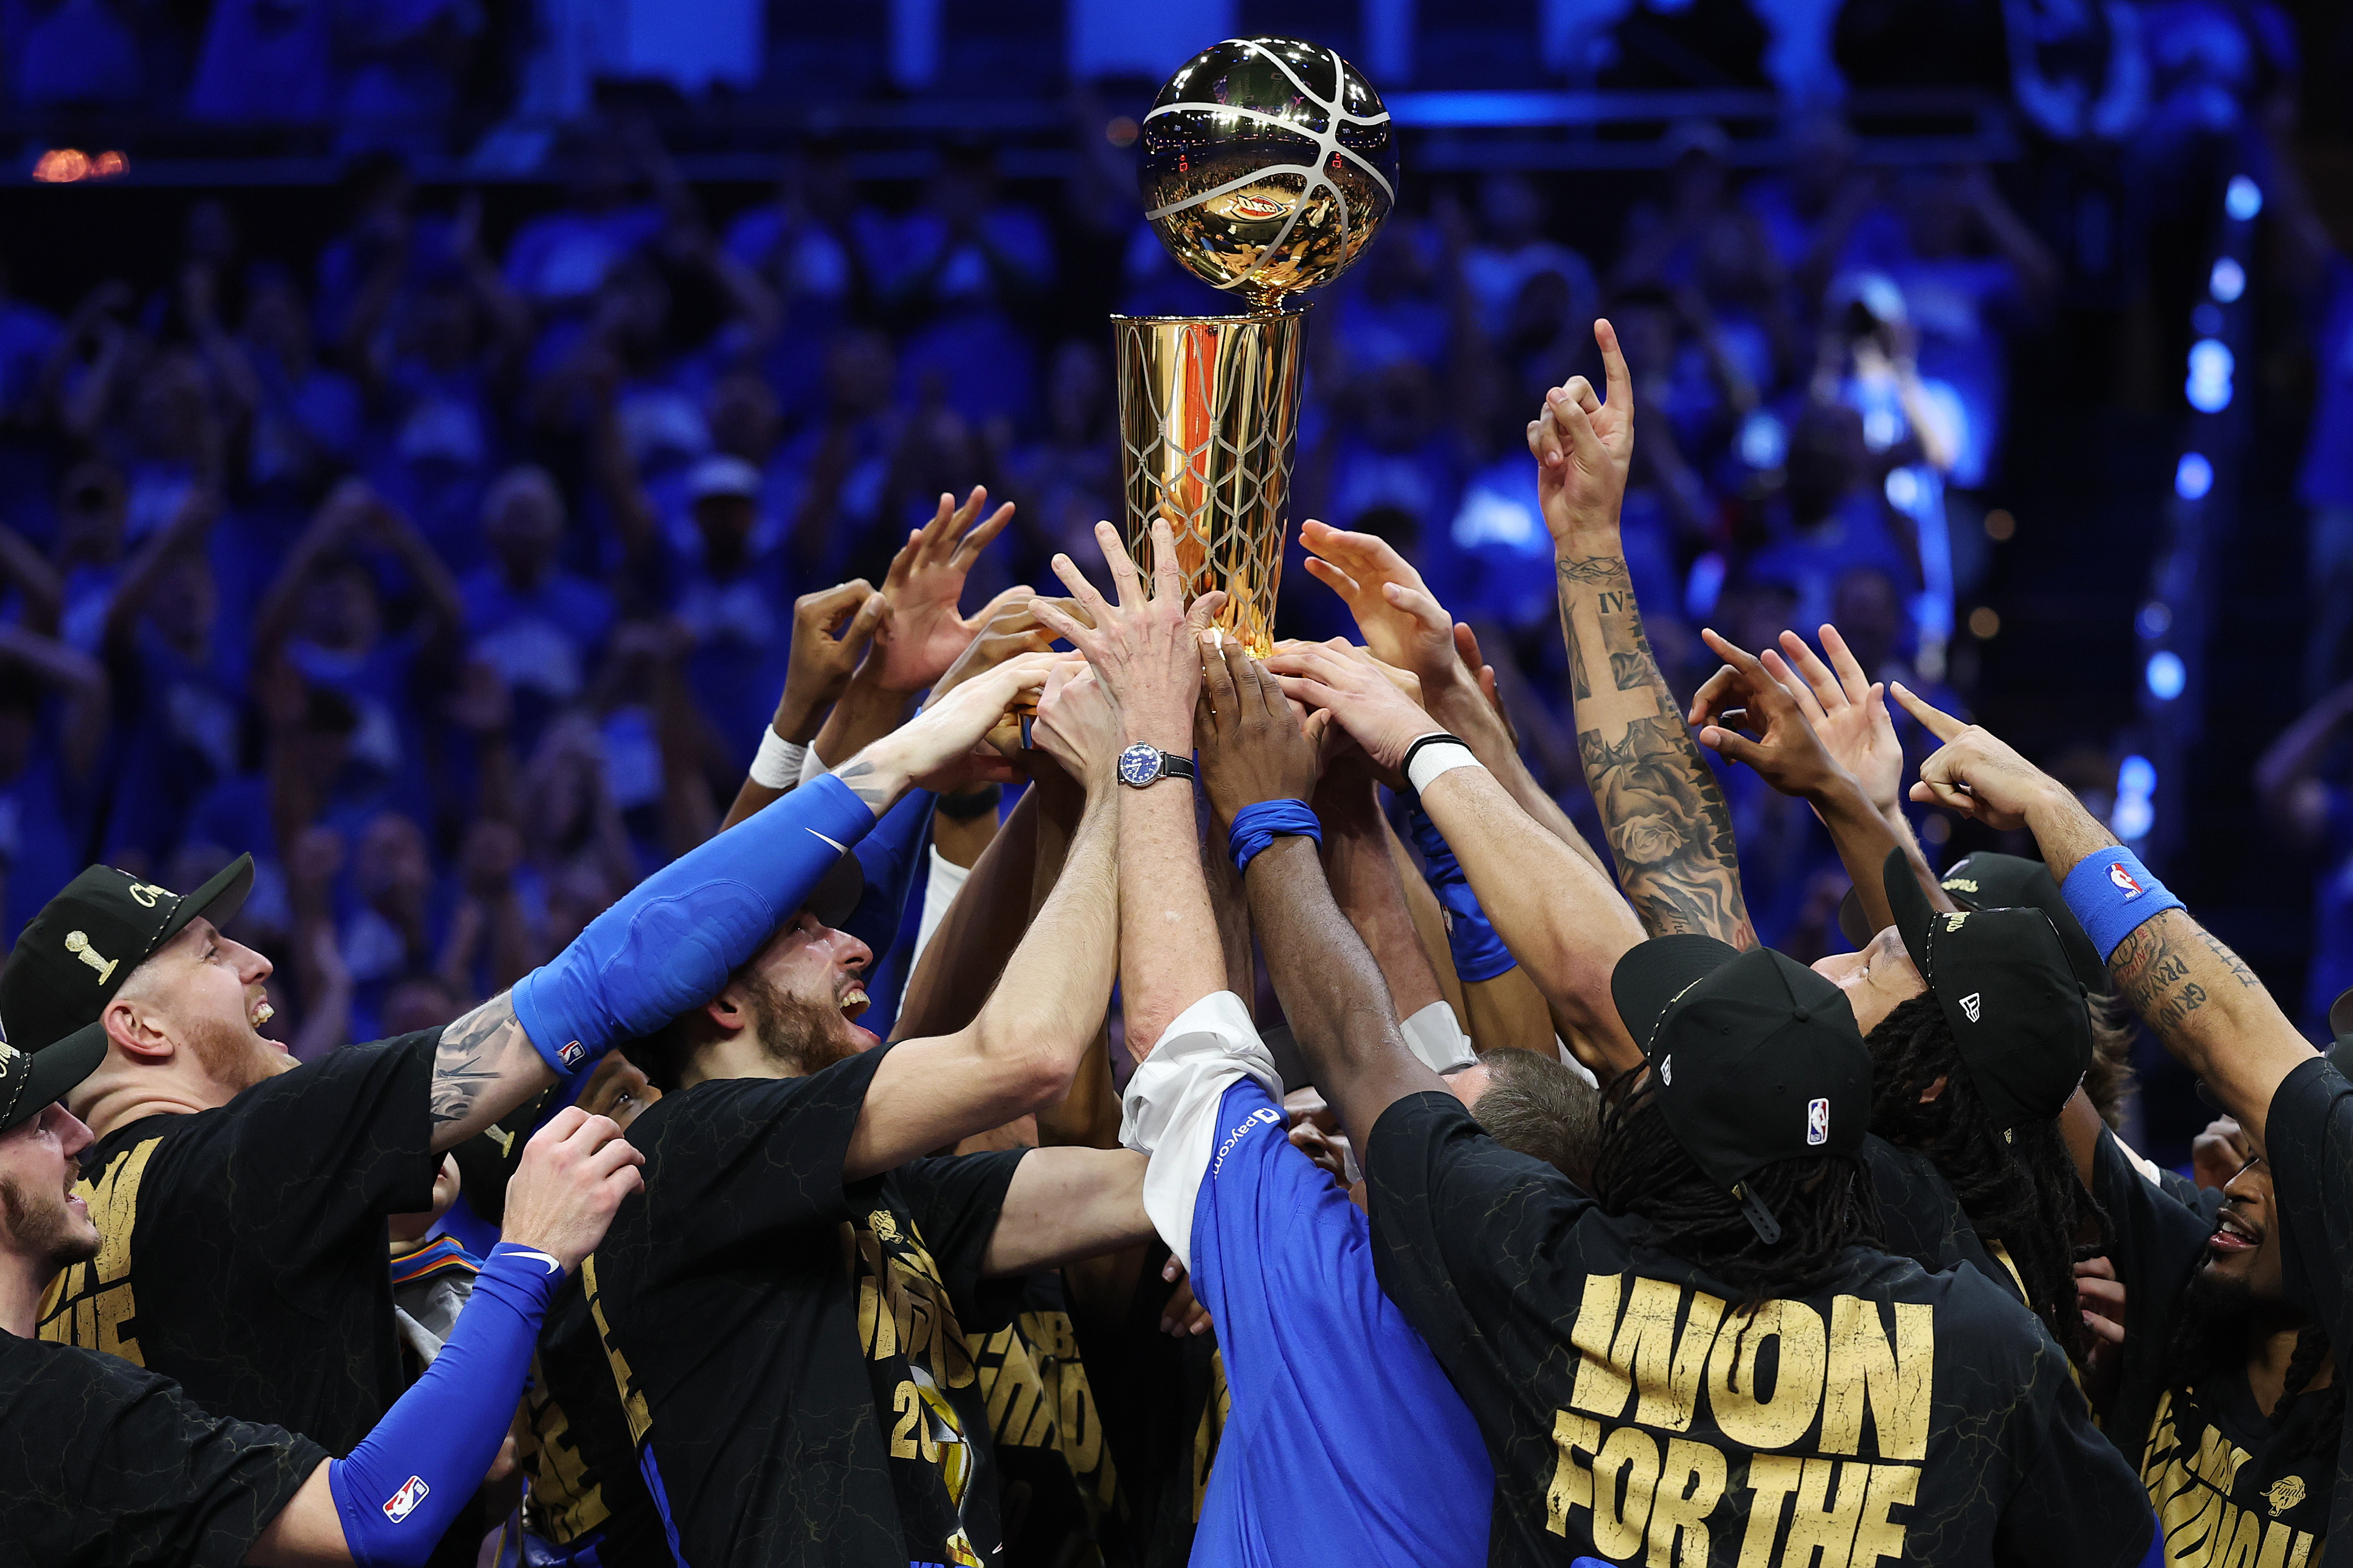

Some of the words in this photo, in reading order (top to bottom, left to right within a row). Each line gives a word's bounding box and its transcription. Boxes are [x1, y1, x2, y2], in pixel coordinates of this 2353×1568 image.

[1598, 591, 1622, 613] IV
[2125, 889, 2138, 899] NBA
[2151, 954, 2191, 996] PRAY
[2160, 982, 2206, 1028] GRIND
[1213, 1116, 1258, 1175] paycom
[1570, 1273, 1934, 1460] WON
[414, 1482, 426, 1495] NBA
[1546, 1409, 1727, 1568] FOR
[1737, 1453, 1922, 1568] THE
